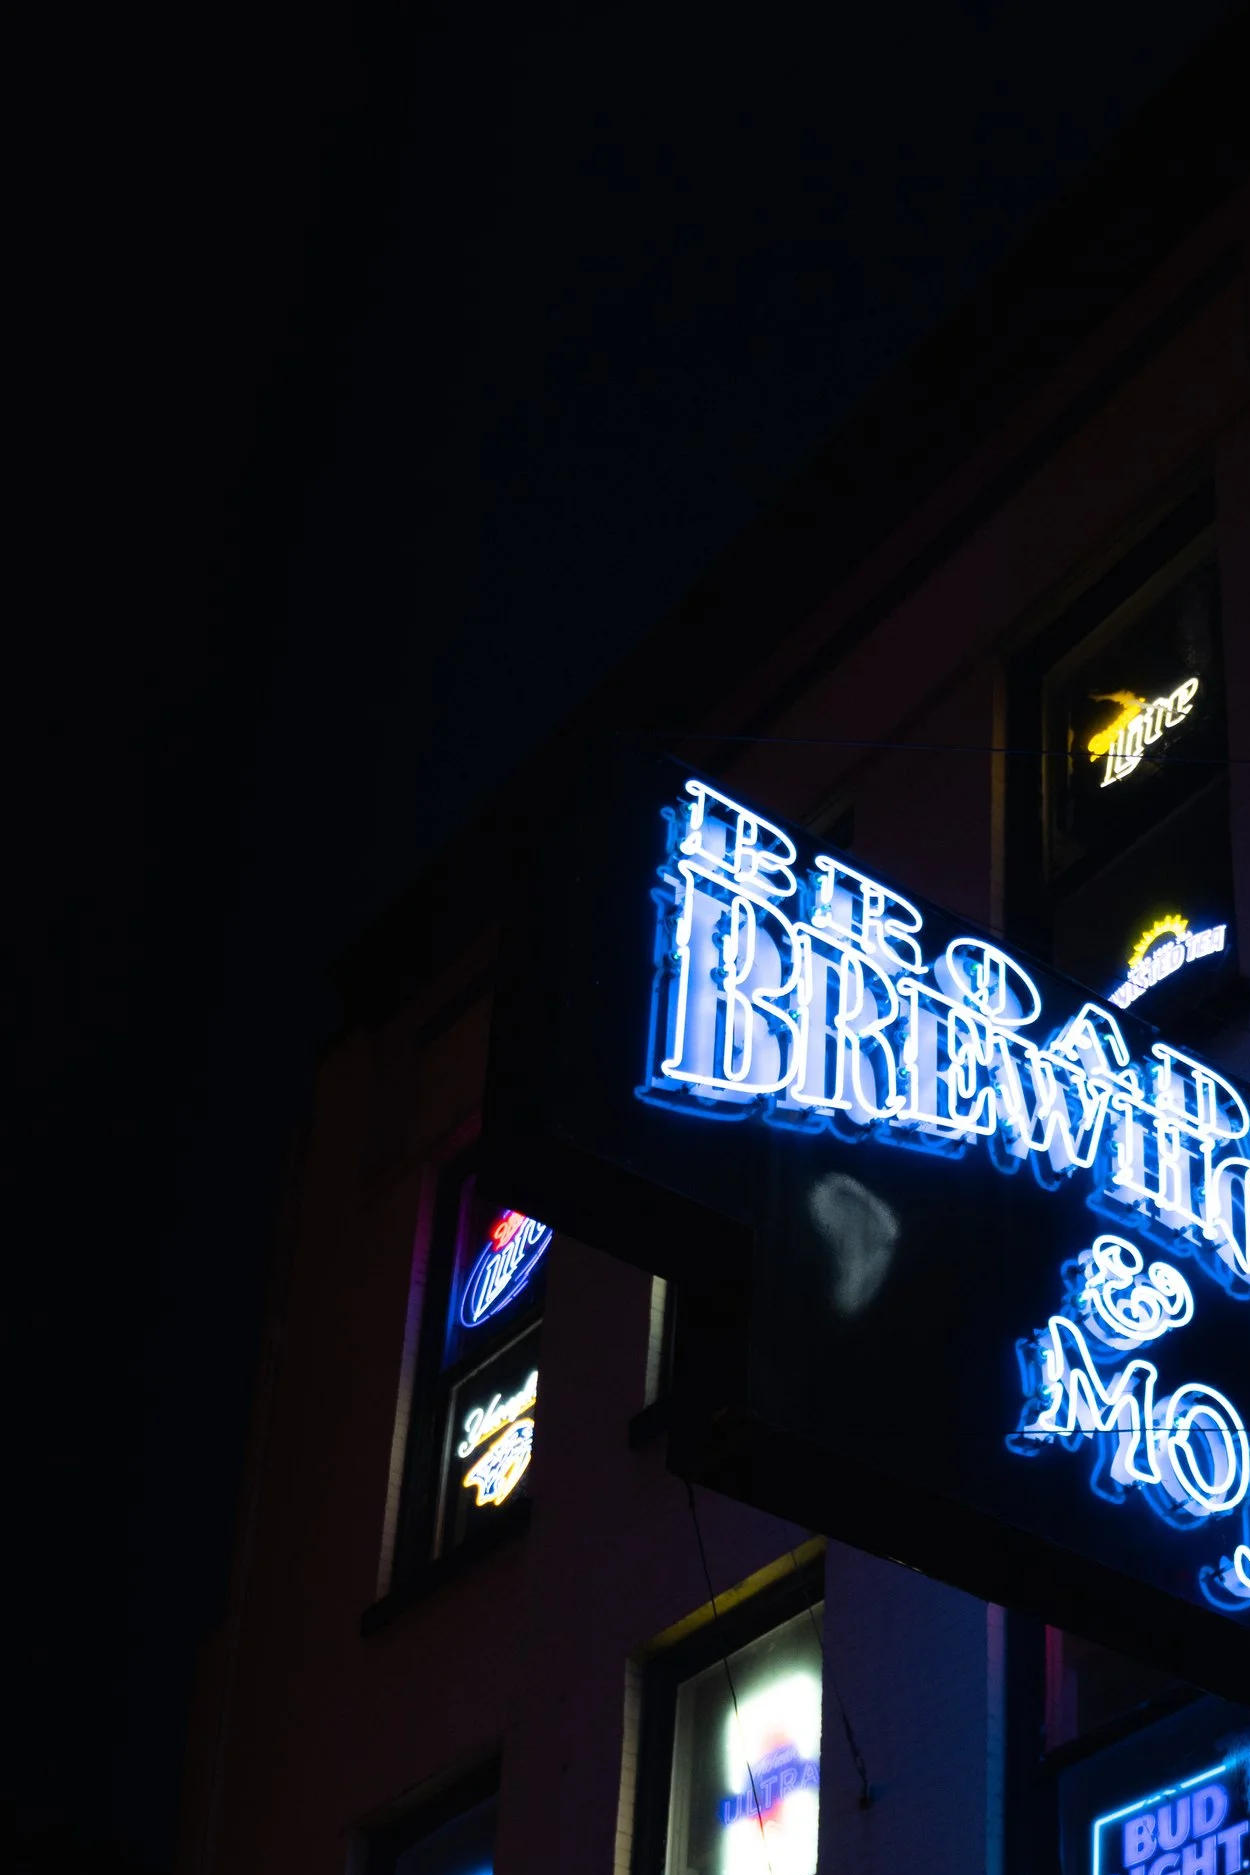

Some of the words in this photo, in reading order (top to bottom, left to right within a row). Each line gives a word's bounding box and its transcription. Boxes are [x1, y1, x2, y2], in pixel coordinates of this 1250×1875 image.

[1075, 1235, 1194, 1348] &
[722, 1760, 820, 1826] ULTRA
[1123, 1782, 1228, 1868] BUD
